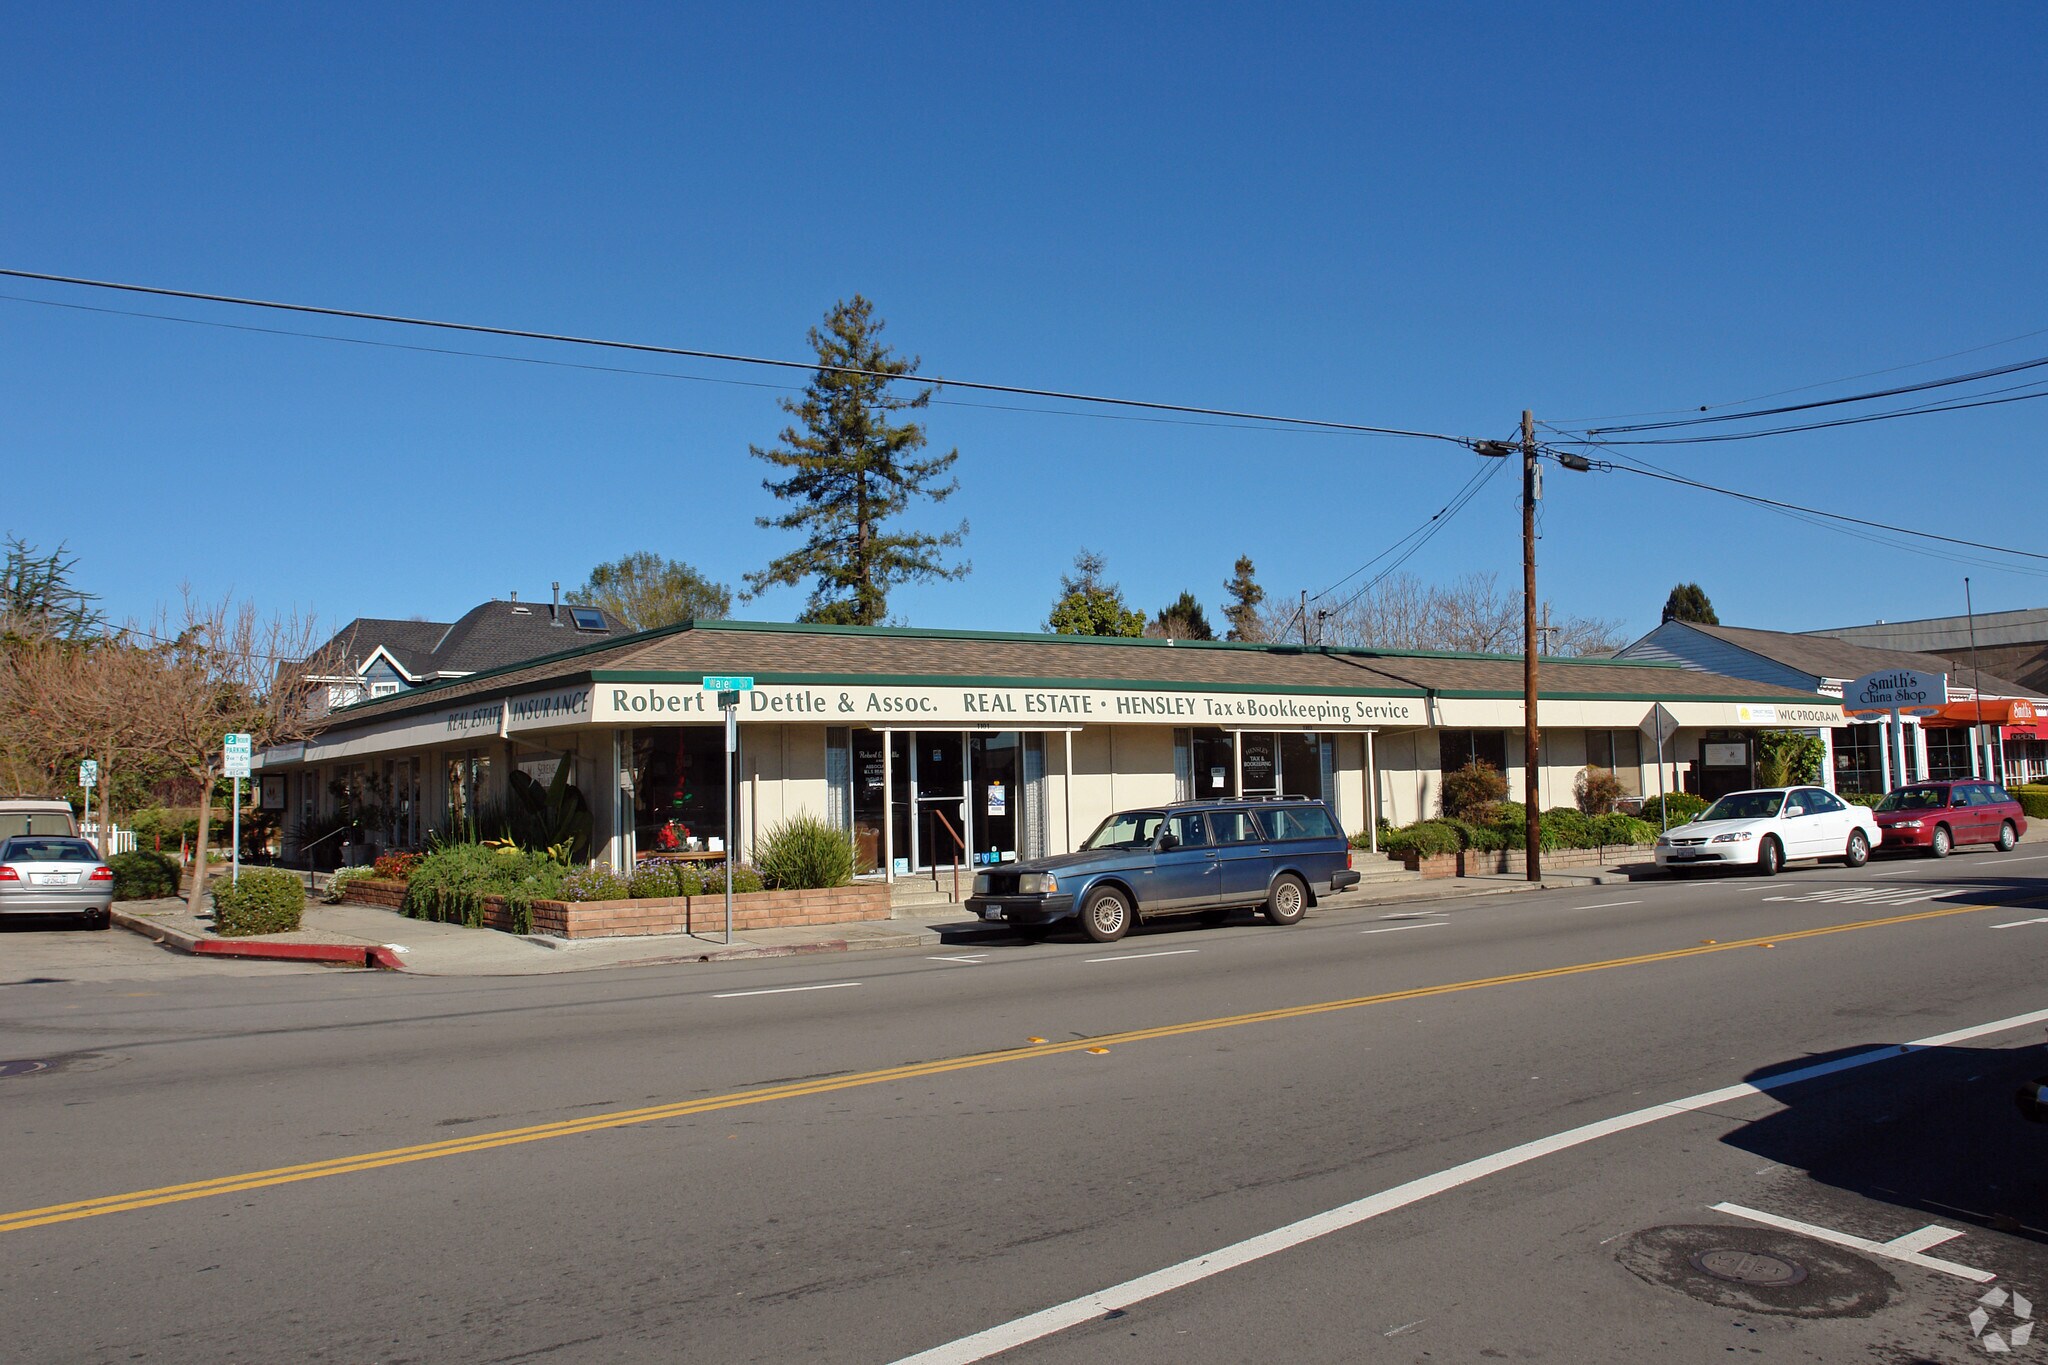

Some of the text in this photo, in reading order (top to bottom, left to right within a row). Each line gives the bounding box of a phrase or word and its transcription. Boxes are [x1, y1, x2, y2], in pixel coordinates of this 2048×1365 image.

[1867, 672, 1917, 692] Smith's
[613, 689, 705, 712] Robert
[750, 690, 826, 712] Dettle
[837, 692, 855, 712] &
[866, 692, 938, 712] Assoc.
[963, 693, 1017, 713] REAL
[1025, 693, 1093, 714] ESTATE
[1859, 689, 1927, 704] China Shop
[447, 691, 589, 732] REAL ESTATE INSURANCE
[1116, 696, 1196, 715] HENSLEY
[1203, 698, 1233, 716] Tax
[1356, 701, 1409, 719] Service
[1778, 709, 1796, 721] WIC
[1797, 710, 1840, 722] PROGRAM
[228, 735, 235, 744] 2
